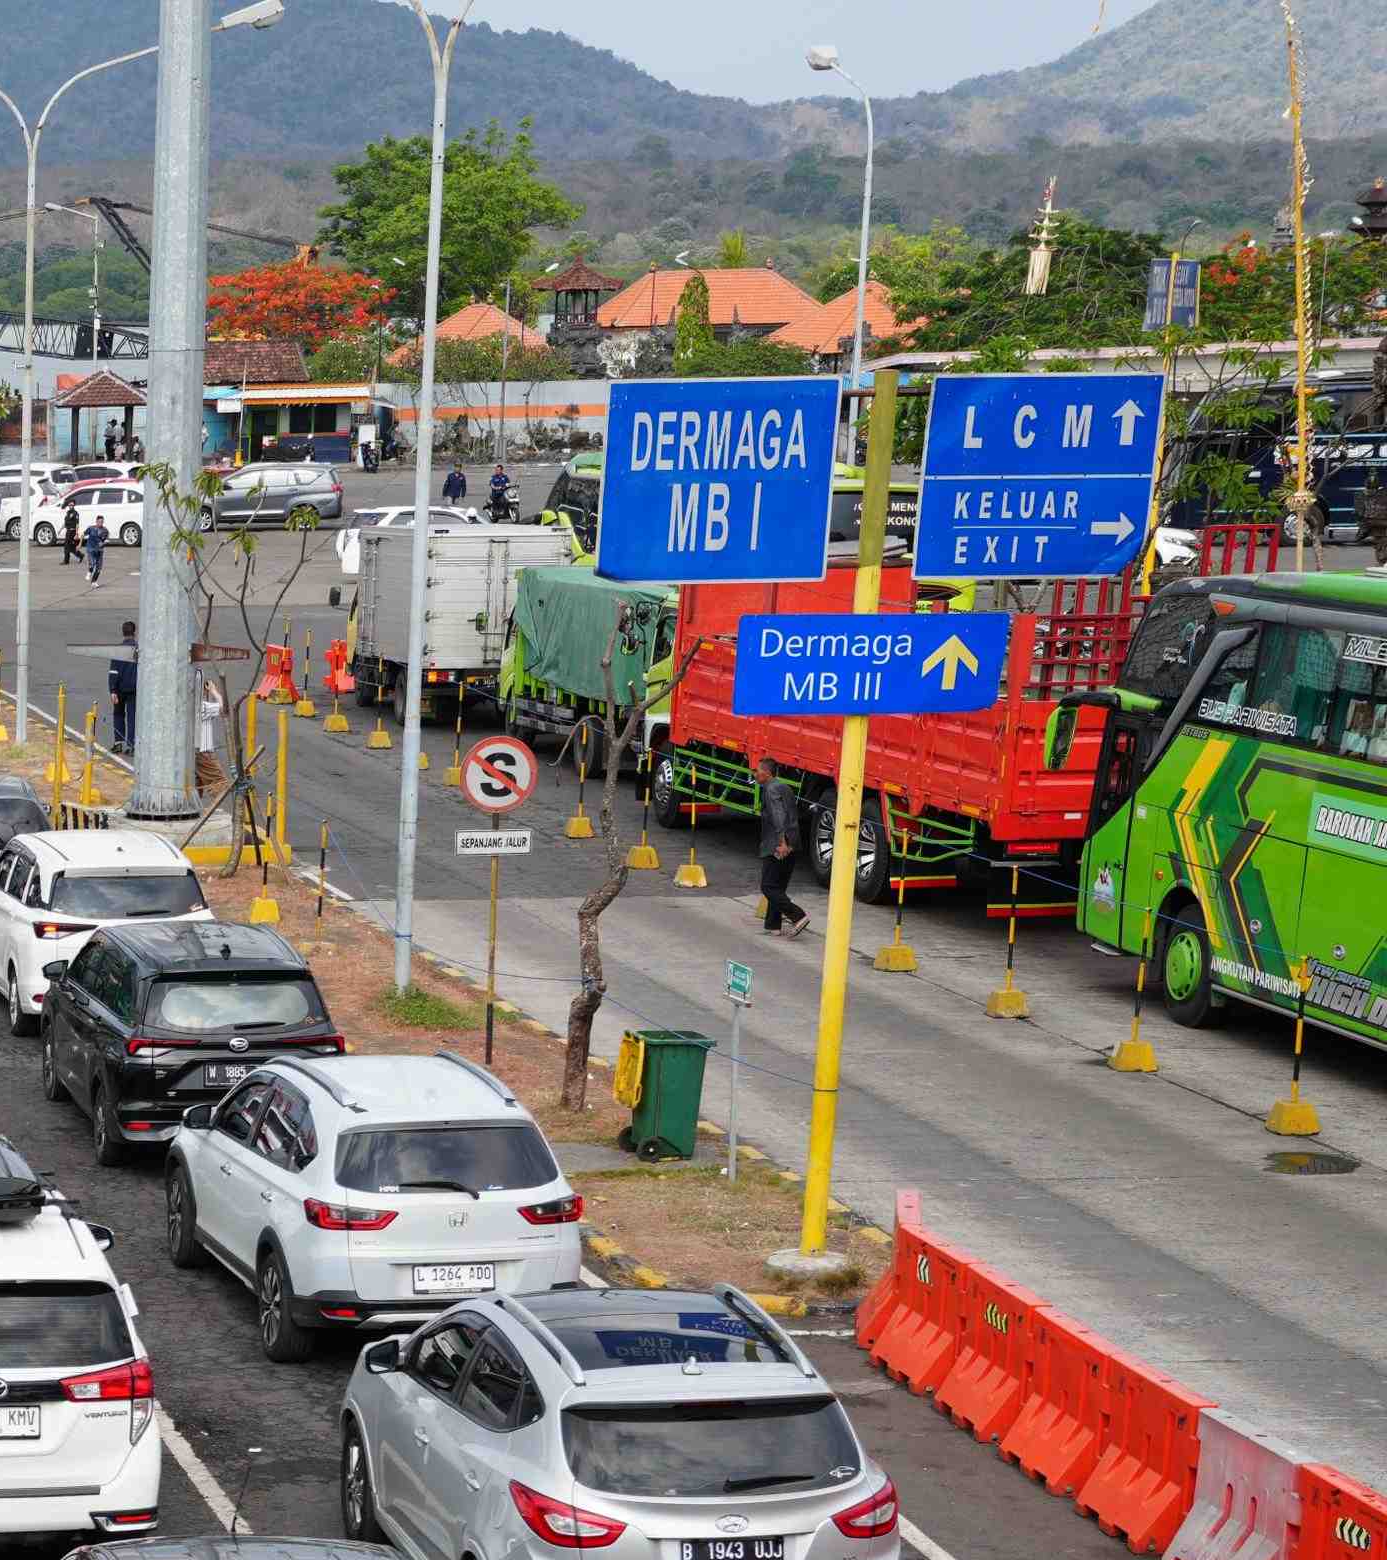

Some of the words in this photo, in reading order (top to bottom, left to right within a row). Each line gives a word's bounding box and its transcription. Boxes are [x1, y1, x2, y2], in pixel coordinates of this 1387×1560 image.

[630, 409, 807, 471] DERMAGA
[667, 482, 730, 552] MB
[750, 481, 762, 551] I
[953, 490, 1079, 520] KELUAR
[954, 536, 1049, 564] EXIT
[760, 628, 913, 665] Dermaga
[783, 672, 838, 701] MB
[853, 672, 882, 700] III
[460, 838, 504, 849] SEPANJANG
[505, 836, 528, 848] JALUR
[417, 1268, 425, 1281] L
[431, 1266, 461, 1281] 1264
[8, 1409, 37, 1427] KMV
[682, 1544, 692, 1560] B
[707, 1542, 745, 1559] 1943
[754, 1541, 783, 1559] UJJ
